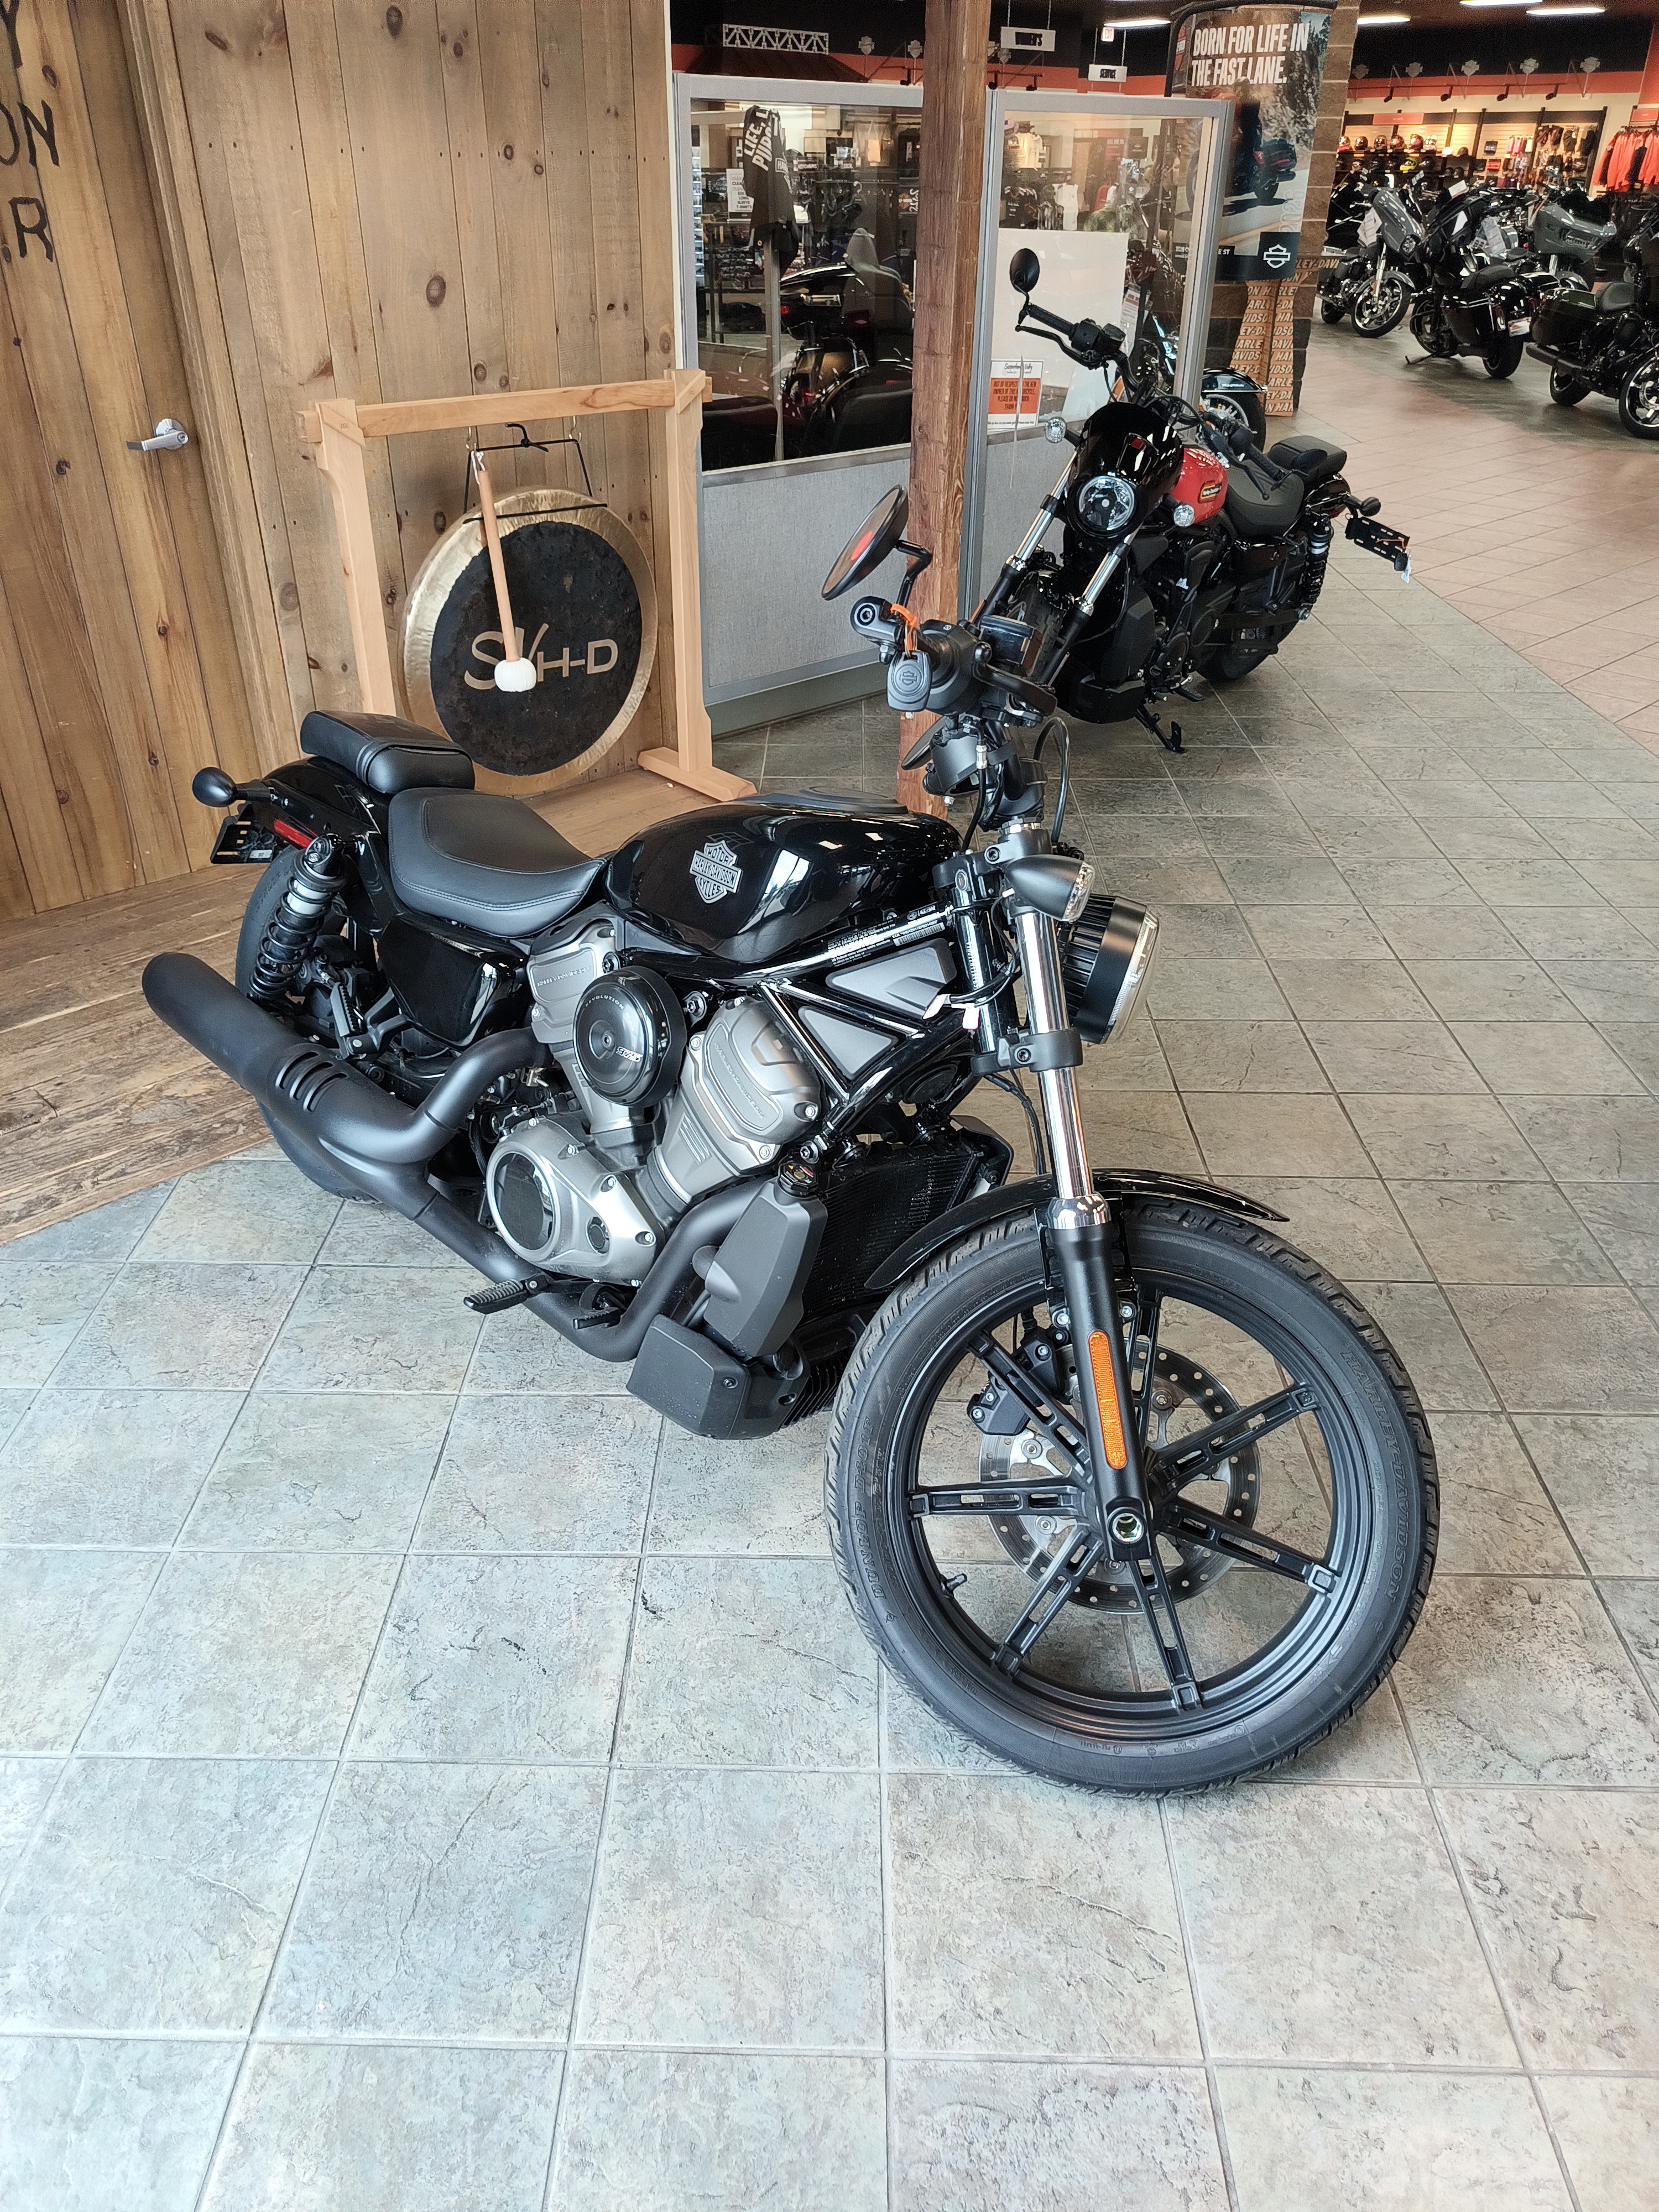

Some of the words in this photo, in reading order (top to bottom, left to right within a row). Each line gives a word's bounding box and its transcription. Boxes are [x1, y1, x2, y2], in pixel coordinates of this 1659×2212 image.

[1193, 27, 1227, 56] BORN
[1228, 25, 1255, 54] FOR
[1256, 23, 1289, 53] LIFE
[1290, 23, 1310, 51] IN
[1191, 59, 1212, 87] THE
[1213, 57, 1246, 86] FAST
[1247, 56, 1287, 84] LANE.
[1296, 259, 1339, 269] LEY-DAVI
[693, 856, 738, 886] HARLEY-DAVIDSON
[707, 847, 730, 865] MOTOR
[585, 995, 624, 1010] REVOLUTION
[854, 1417, 874, 1493] D401F
[1341, 1351, 1410, 1603] HARLEY-DAVIDSON
[855, 1501, 887, 1599] DUNLOP
